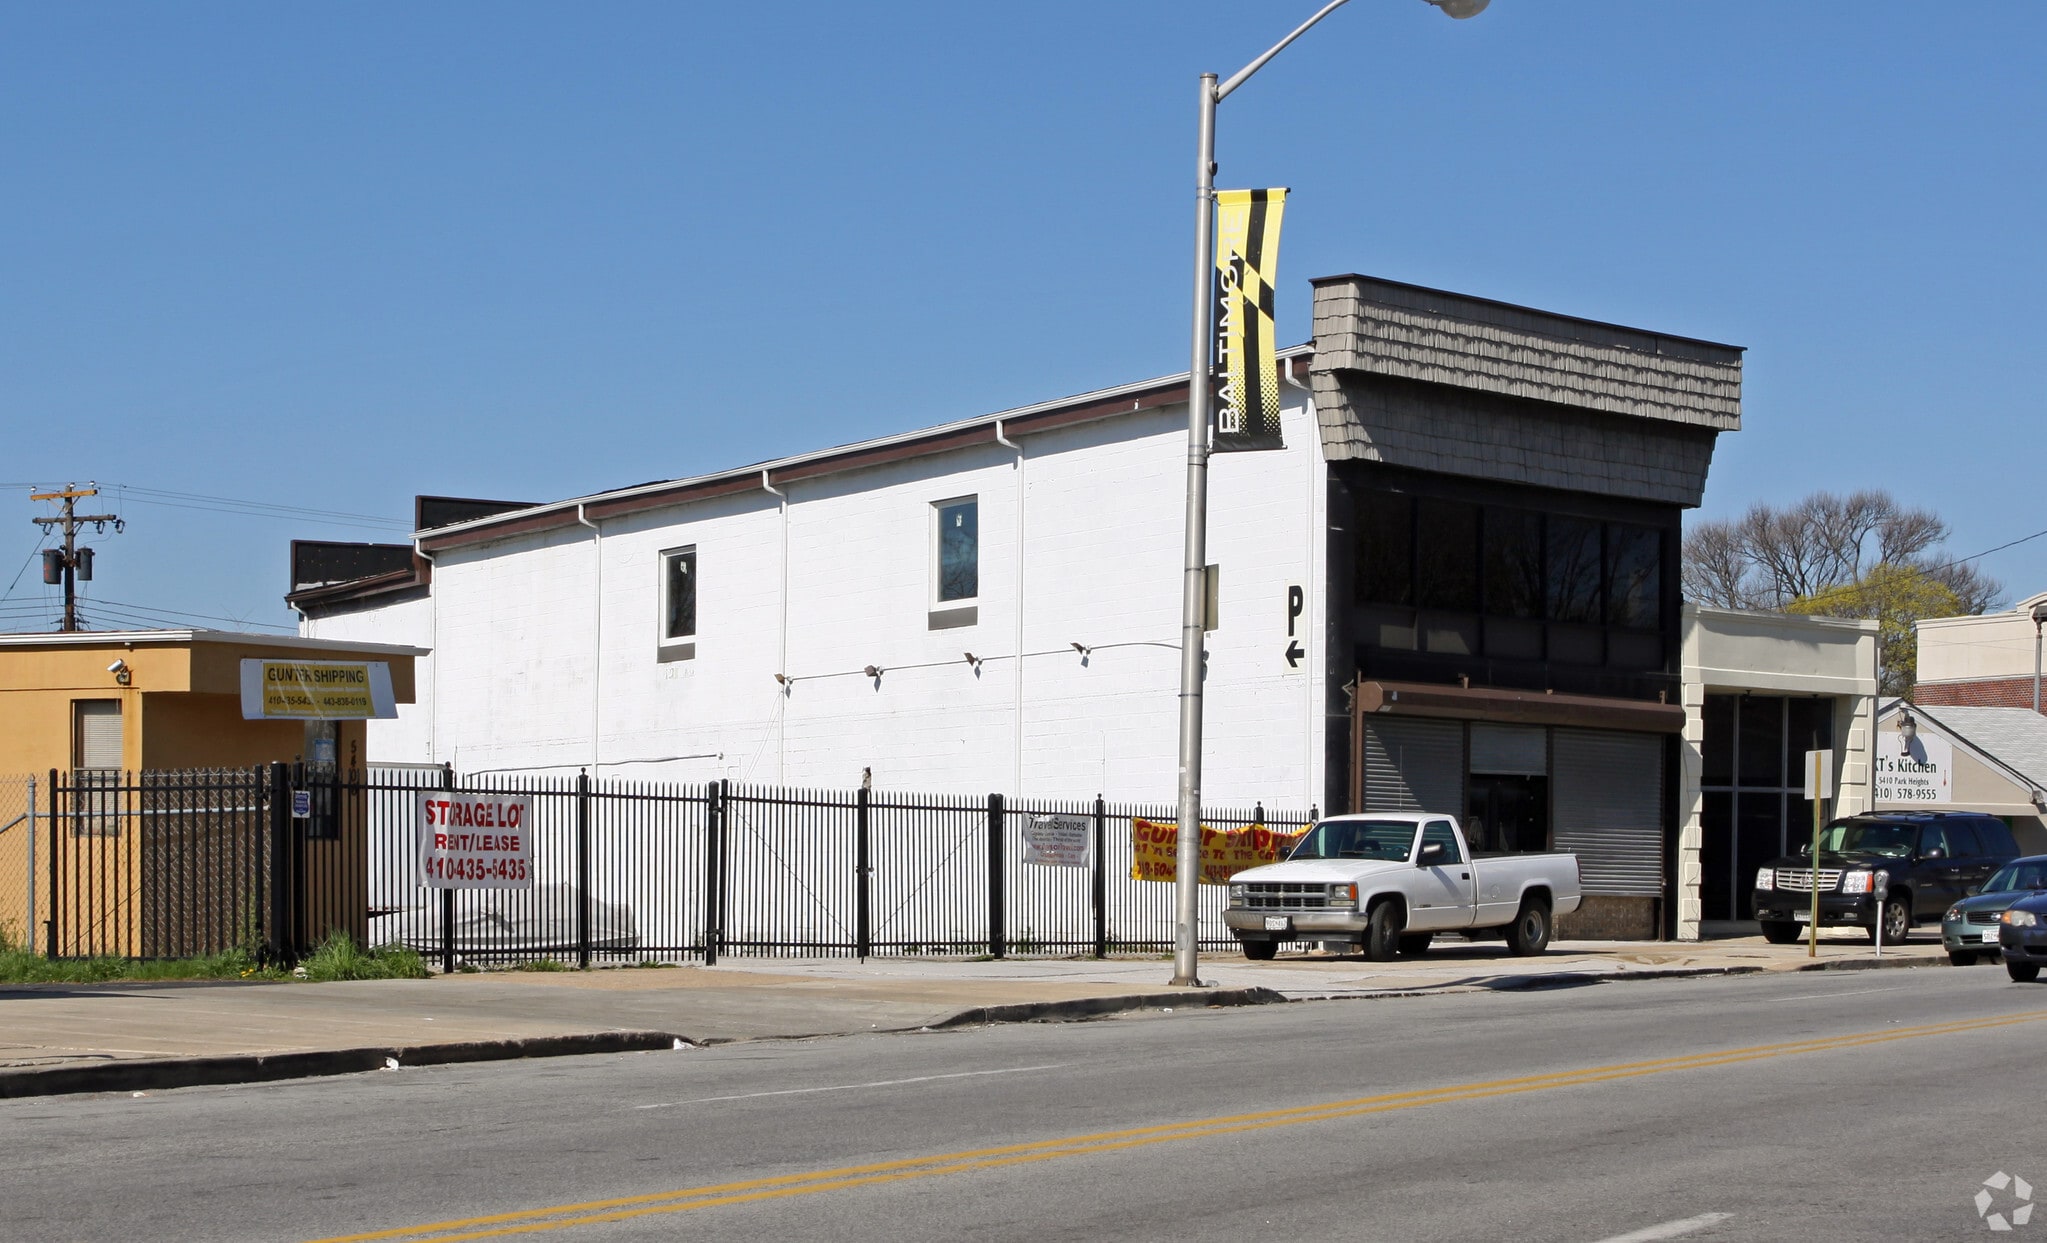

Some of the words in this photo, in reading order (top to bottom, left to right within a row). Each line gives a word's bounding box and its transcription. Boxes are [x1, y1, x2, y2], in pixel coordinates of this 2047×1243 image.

[1218, 211, 1244, 434] BALTIMORE
[1288, 585, 1304, 637] P
[314, 669, 364, 683] SHIPPING
[1898, 758, 1937, 774] Kitchen
[1879, 776, 1893, 785] 5410
[1895, 777, 1907, 785] Park
[1908, 778, 1930, 788] Heights
[1897, 788, 1937, 800] 578-9555
[425, 799, 494, 827] STORAGE
[497, 803, 524, 828] LOT
[434, 832, 520, 853] RENT/LEASE
